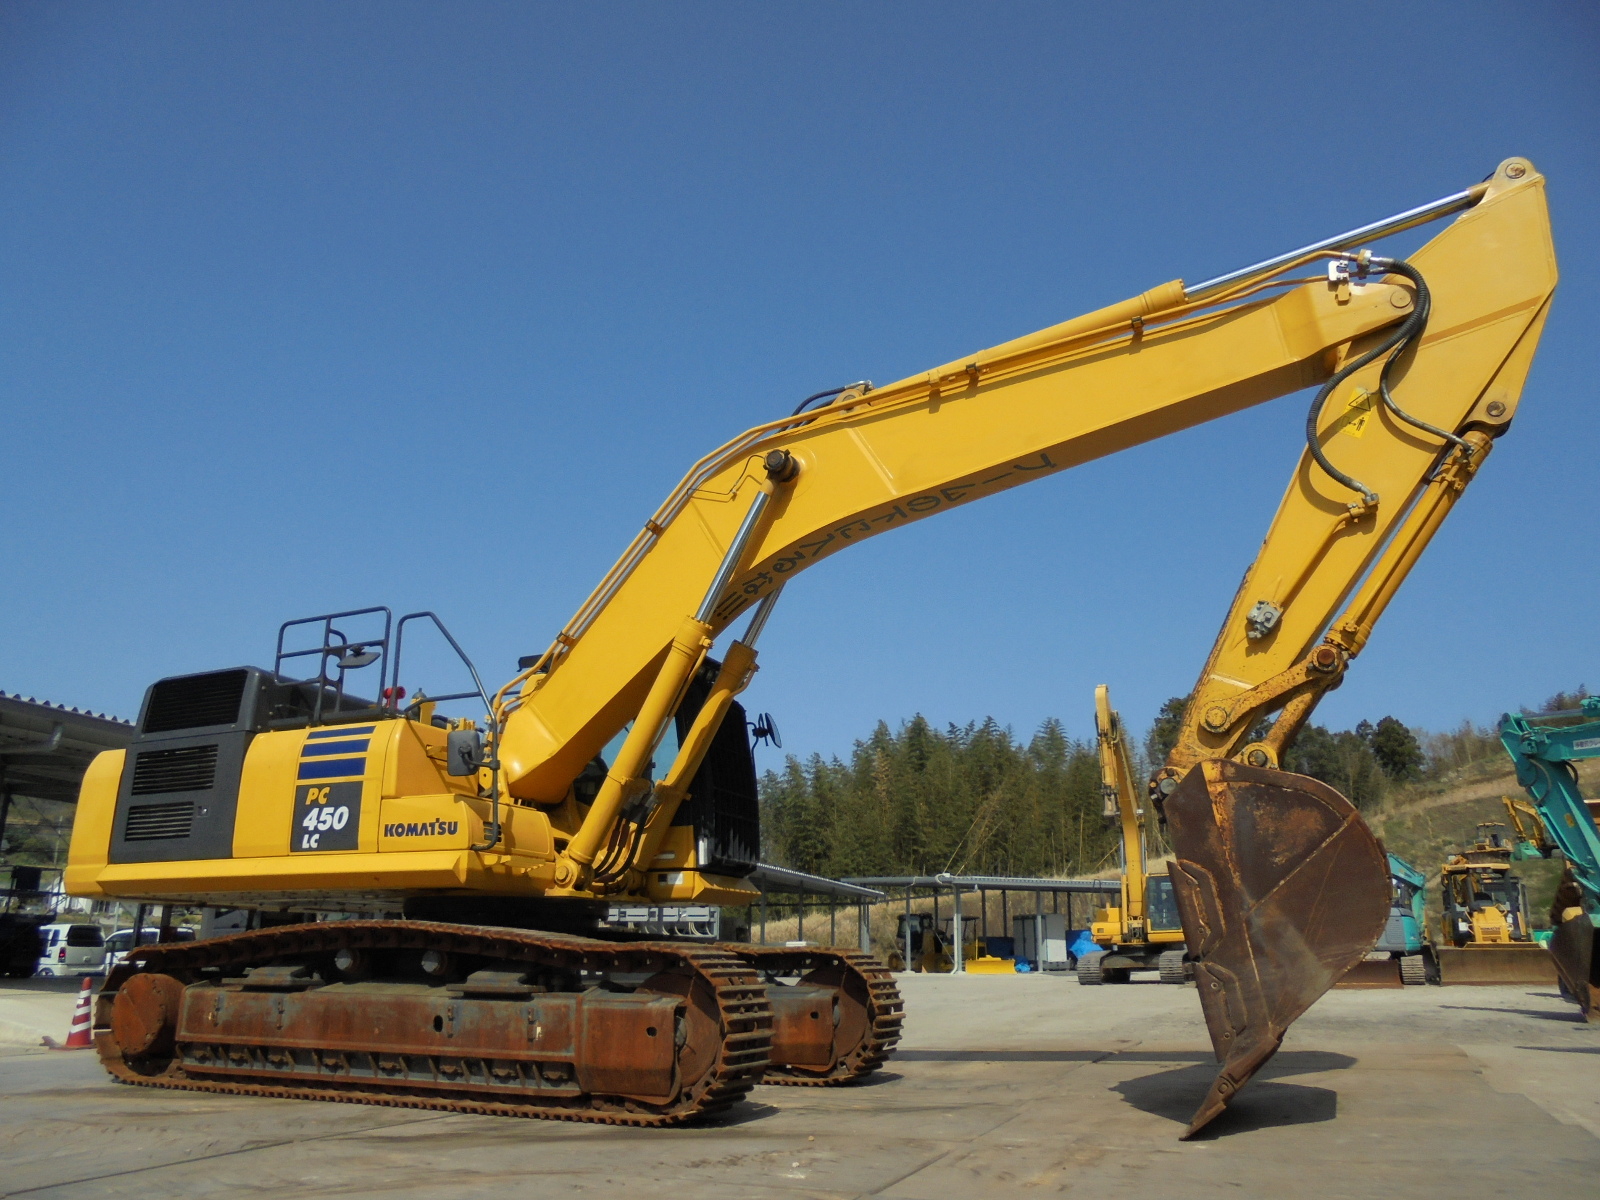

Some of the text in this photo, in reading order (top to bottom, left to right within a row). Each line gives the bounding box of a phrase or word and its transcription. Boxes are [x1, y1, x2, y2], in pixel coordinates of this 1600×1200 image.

[305, 786, 330, 805] PC
[302, 805, 350, 831] 450
[384, 818, 458, 837] KOMATSU
[302, 833, 320, 849] LC
